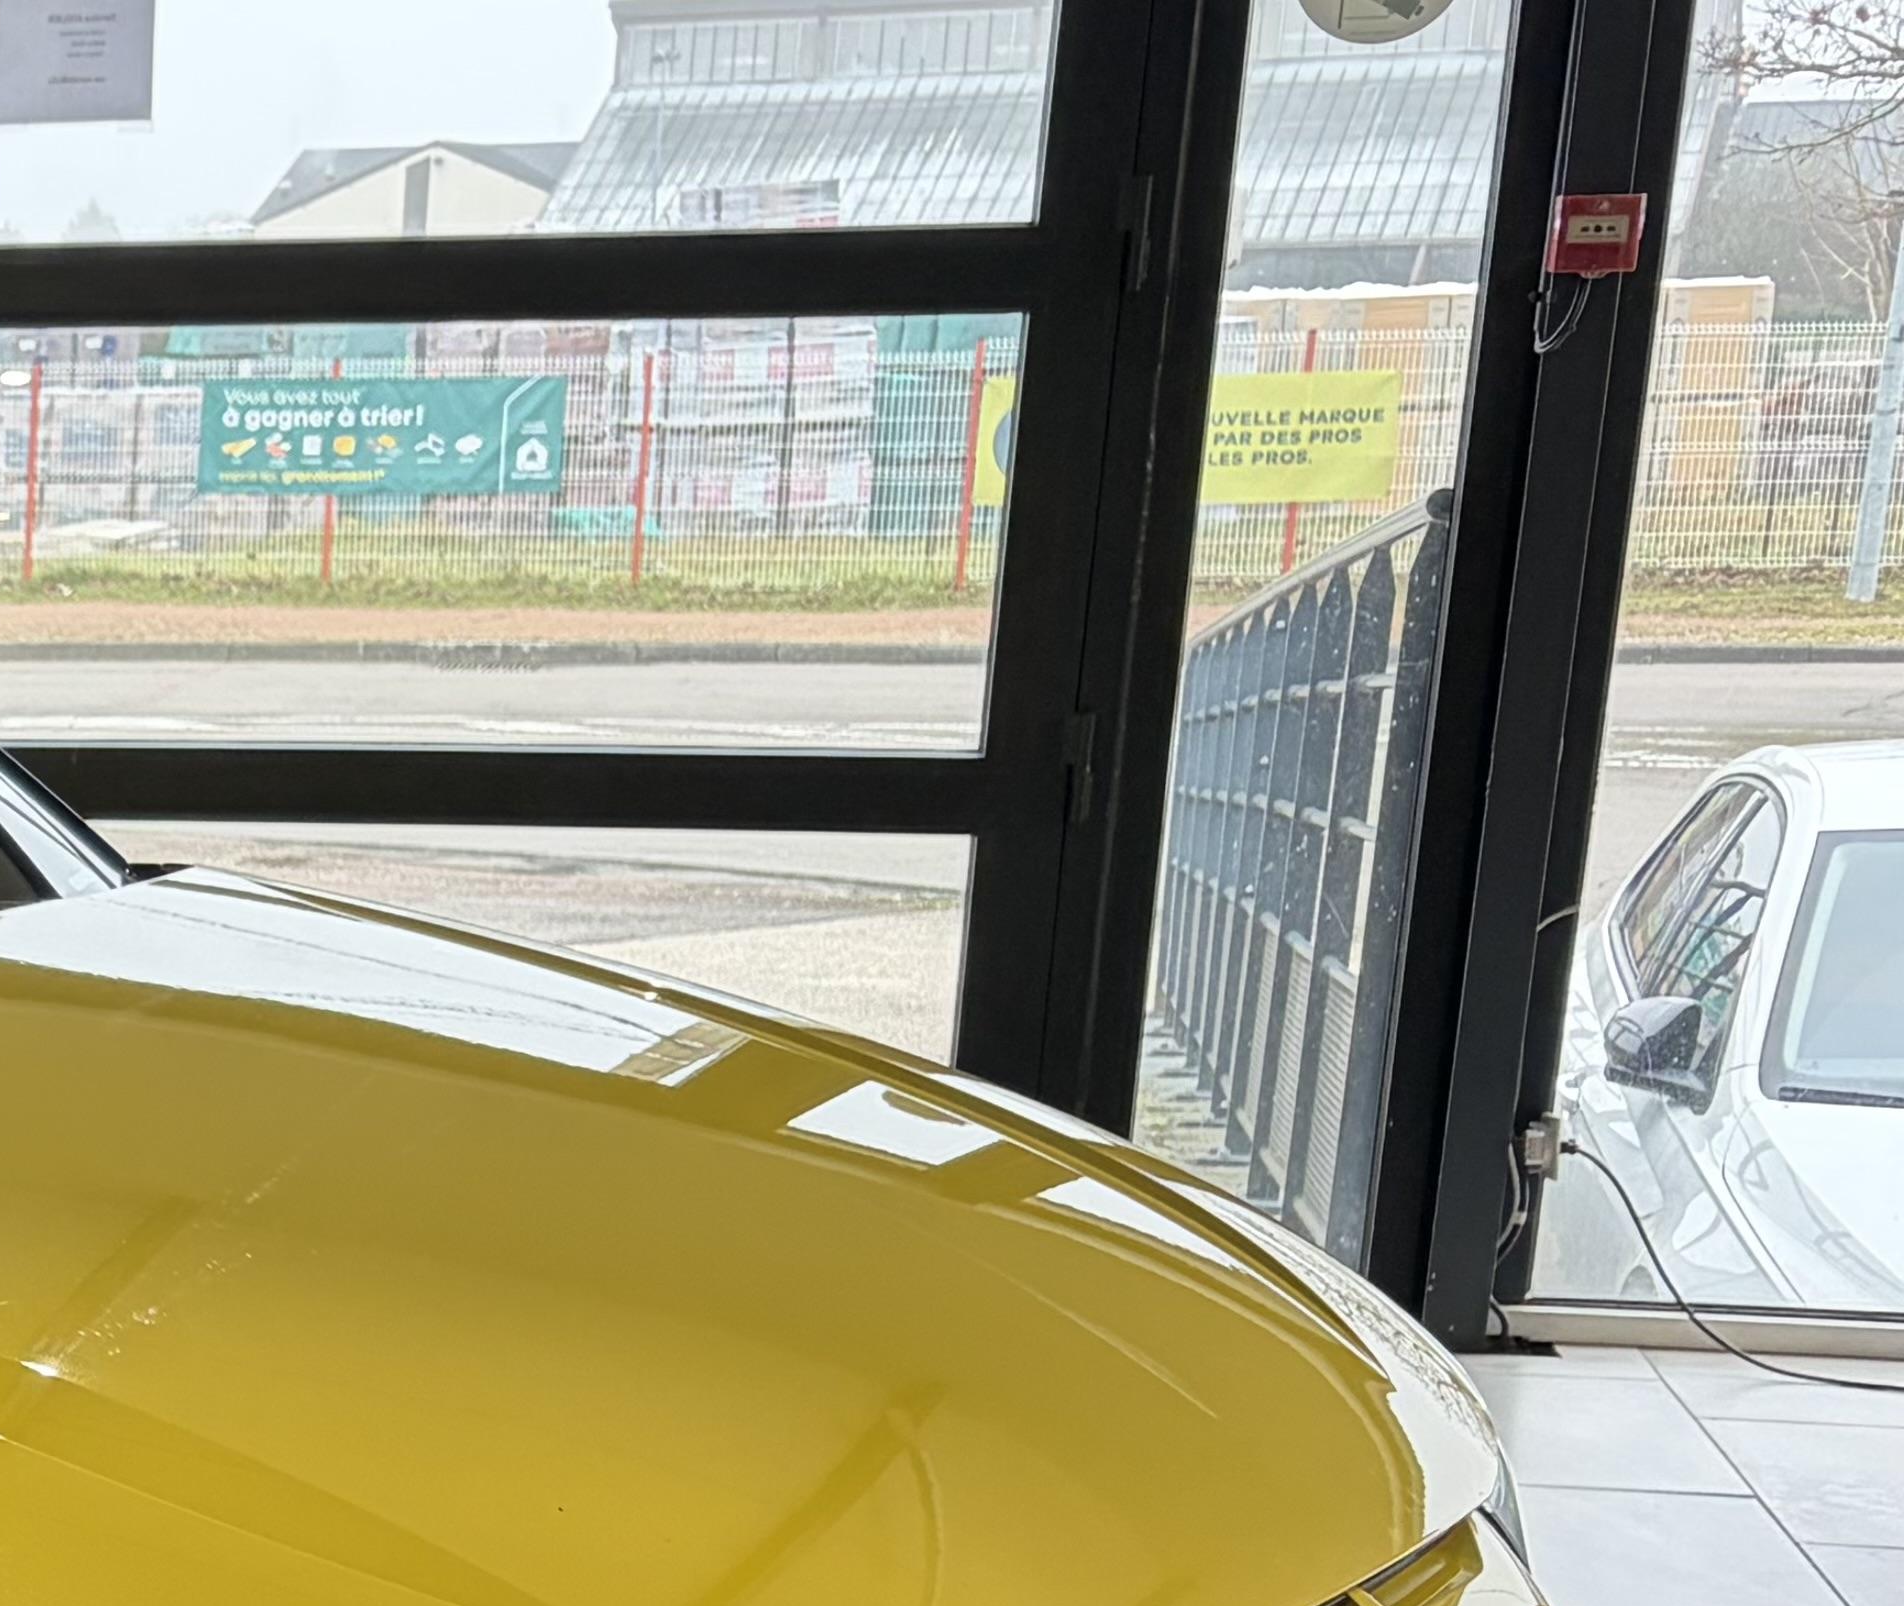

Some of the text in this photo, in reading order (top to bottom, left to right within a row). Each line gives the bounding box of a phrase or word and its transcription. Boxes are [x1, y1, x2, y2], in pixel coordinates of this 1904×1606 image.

[222, 405, 240, 428] à
[244, 409, 334, 432] gagner
[337, 405, 356, 428] à
[1299, 408, 1385, 425] MARQUE
[1213, 428, 1363, 446] PAR DES PROS
[1251, 450, 1313, 466] PROS.
